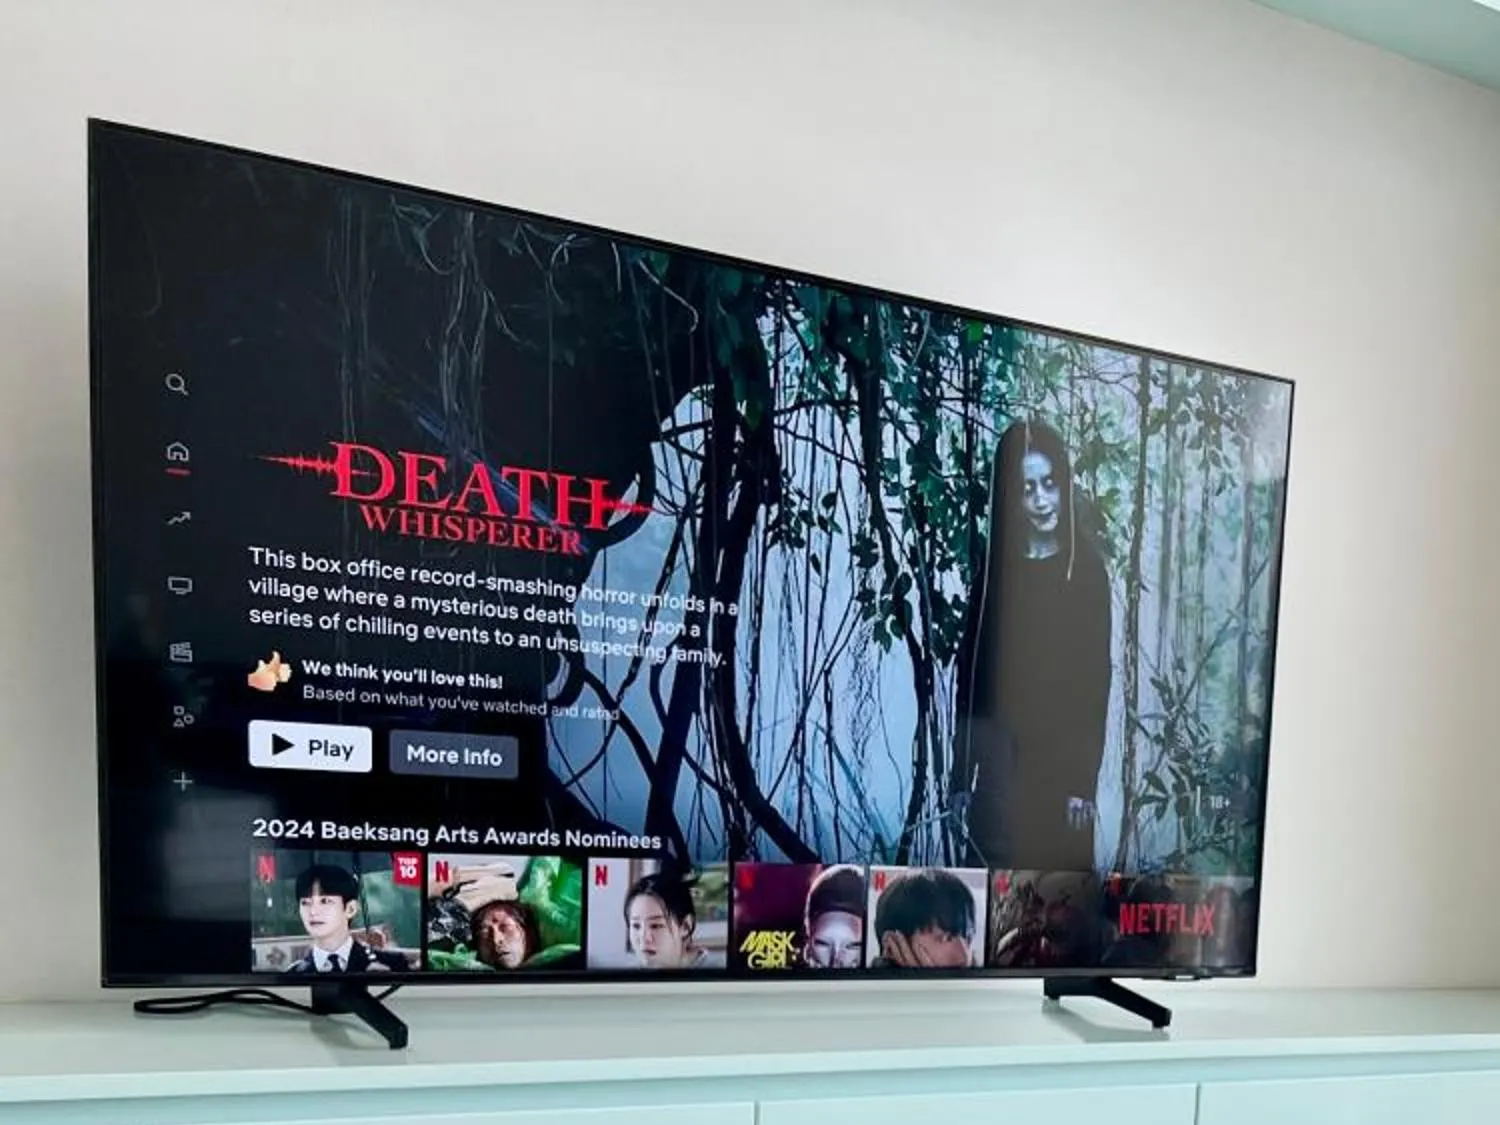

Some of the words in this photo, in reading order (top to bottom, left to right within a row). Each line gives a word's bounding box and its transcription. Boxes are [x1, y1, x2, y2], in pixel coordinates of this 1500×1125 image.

[328, 441, 609, 530] DEATH
[360, 504, 583, 556] WHISPERER
[248, 546, 297, 569] This
[301, 551, 342, 574] box
[346, 558, 405, 581] office
[411, 567, 577, 601] record-smashing
[581, 585, 641, 606] horror
[641, 592, 705, 614] unfolds
[709, 596, 724, 615] in
[727, 602, 739, 617] a
[248, 577, 319, 603] village
[324, 584, 389, 608] where
[393, 595, 406, 610] a
[411, 595, 519, 620] mysterious
[523, 603, 577, 626] death
[581, 610, 638, 635] brings
[641, 620, 687, 638] upon
[689, 624, 701, 638] a
[249, 607, 314, 629] series
[318, 611, 341, 631] of
[345, 613, 419, 642] chilling
[423, 623, 490, 645] events
[493, 629, 515, 648] to
[517, 632, 541, 649] an
[546, 634, 667, 665] unsuspecting
[670, 645, 728, 667] family.
[301, 659, 332, 677] We
[335, 661, 379, 681] think
[382, 668, 428, 684] you'll
[431, 670, 465, 687] love
[468, 673, 504, 690] this!
[303, 684, 356, 703] Based
[359, 691, 381, 704] on
[385, 692, 425, 708] what
[427, 694, 480, 712] you've
[483, 700, 548, 716] watched
[551, 704, 579, 718] and
[308, 738, 354, 762] Play
[406, 743, 459, 764] More
[463, 747, 503, 767] Info
[252, 818, 316, 840] 2024
[320, 820, 429, 847] Baeksang
[434, 824, 480, 844] Arts
[483, 826, 561, 846] Awards
[565, 829, 663, 850] Nominees
[399, 864, 417, 879] 10
[434, 860, 449, 883] N
[595, 865, 608, 887] N
[1118, 902, 1216, 936] NETFLIX
[739, 930, 797, 953] MASK
